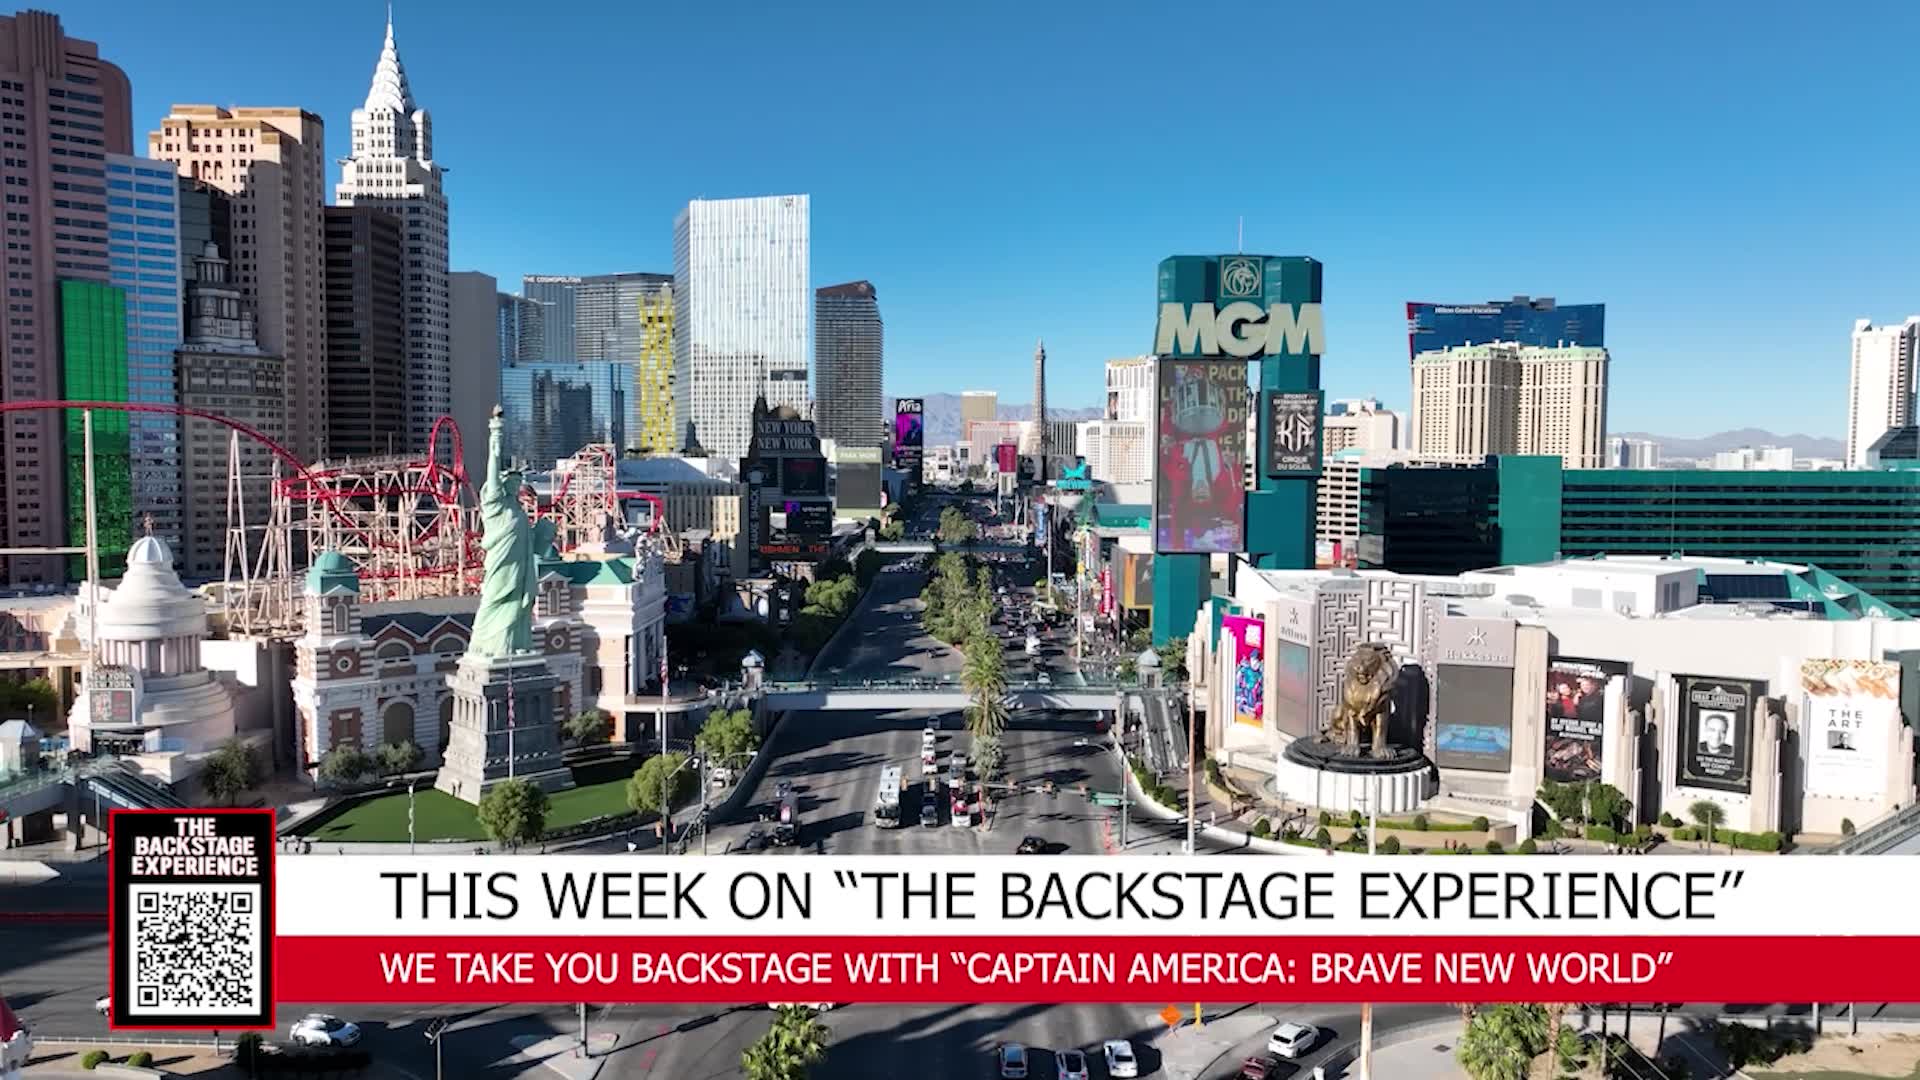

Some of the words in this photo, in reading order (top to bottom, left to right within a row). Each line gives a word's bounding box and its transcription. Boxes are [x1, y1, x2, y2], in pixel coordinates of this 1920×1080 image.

[1155, 301, 1326, 357] MGM
[898, 400, 921, 412] Aria
[757, 421, 781, 434] NEW
[783, 421, 813, 434] YORK
[757, 437, 781, 449] NEW
[783, 437, 813, 449] YORK
[1829, 709, 1863, 719] THE
[1828, 719, 1862, 728] ART
